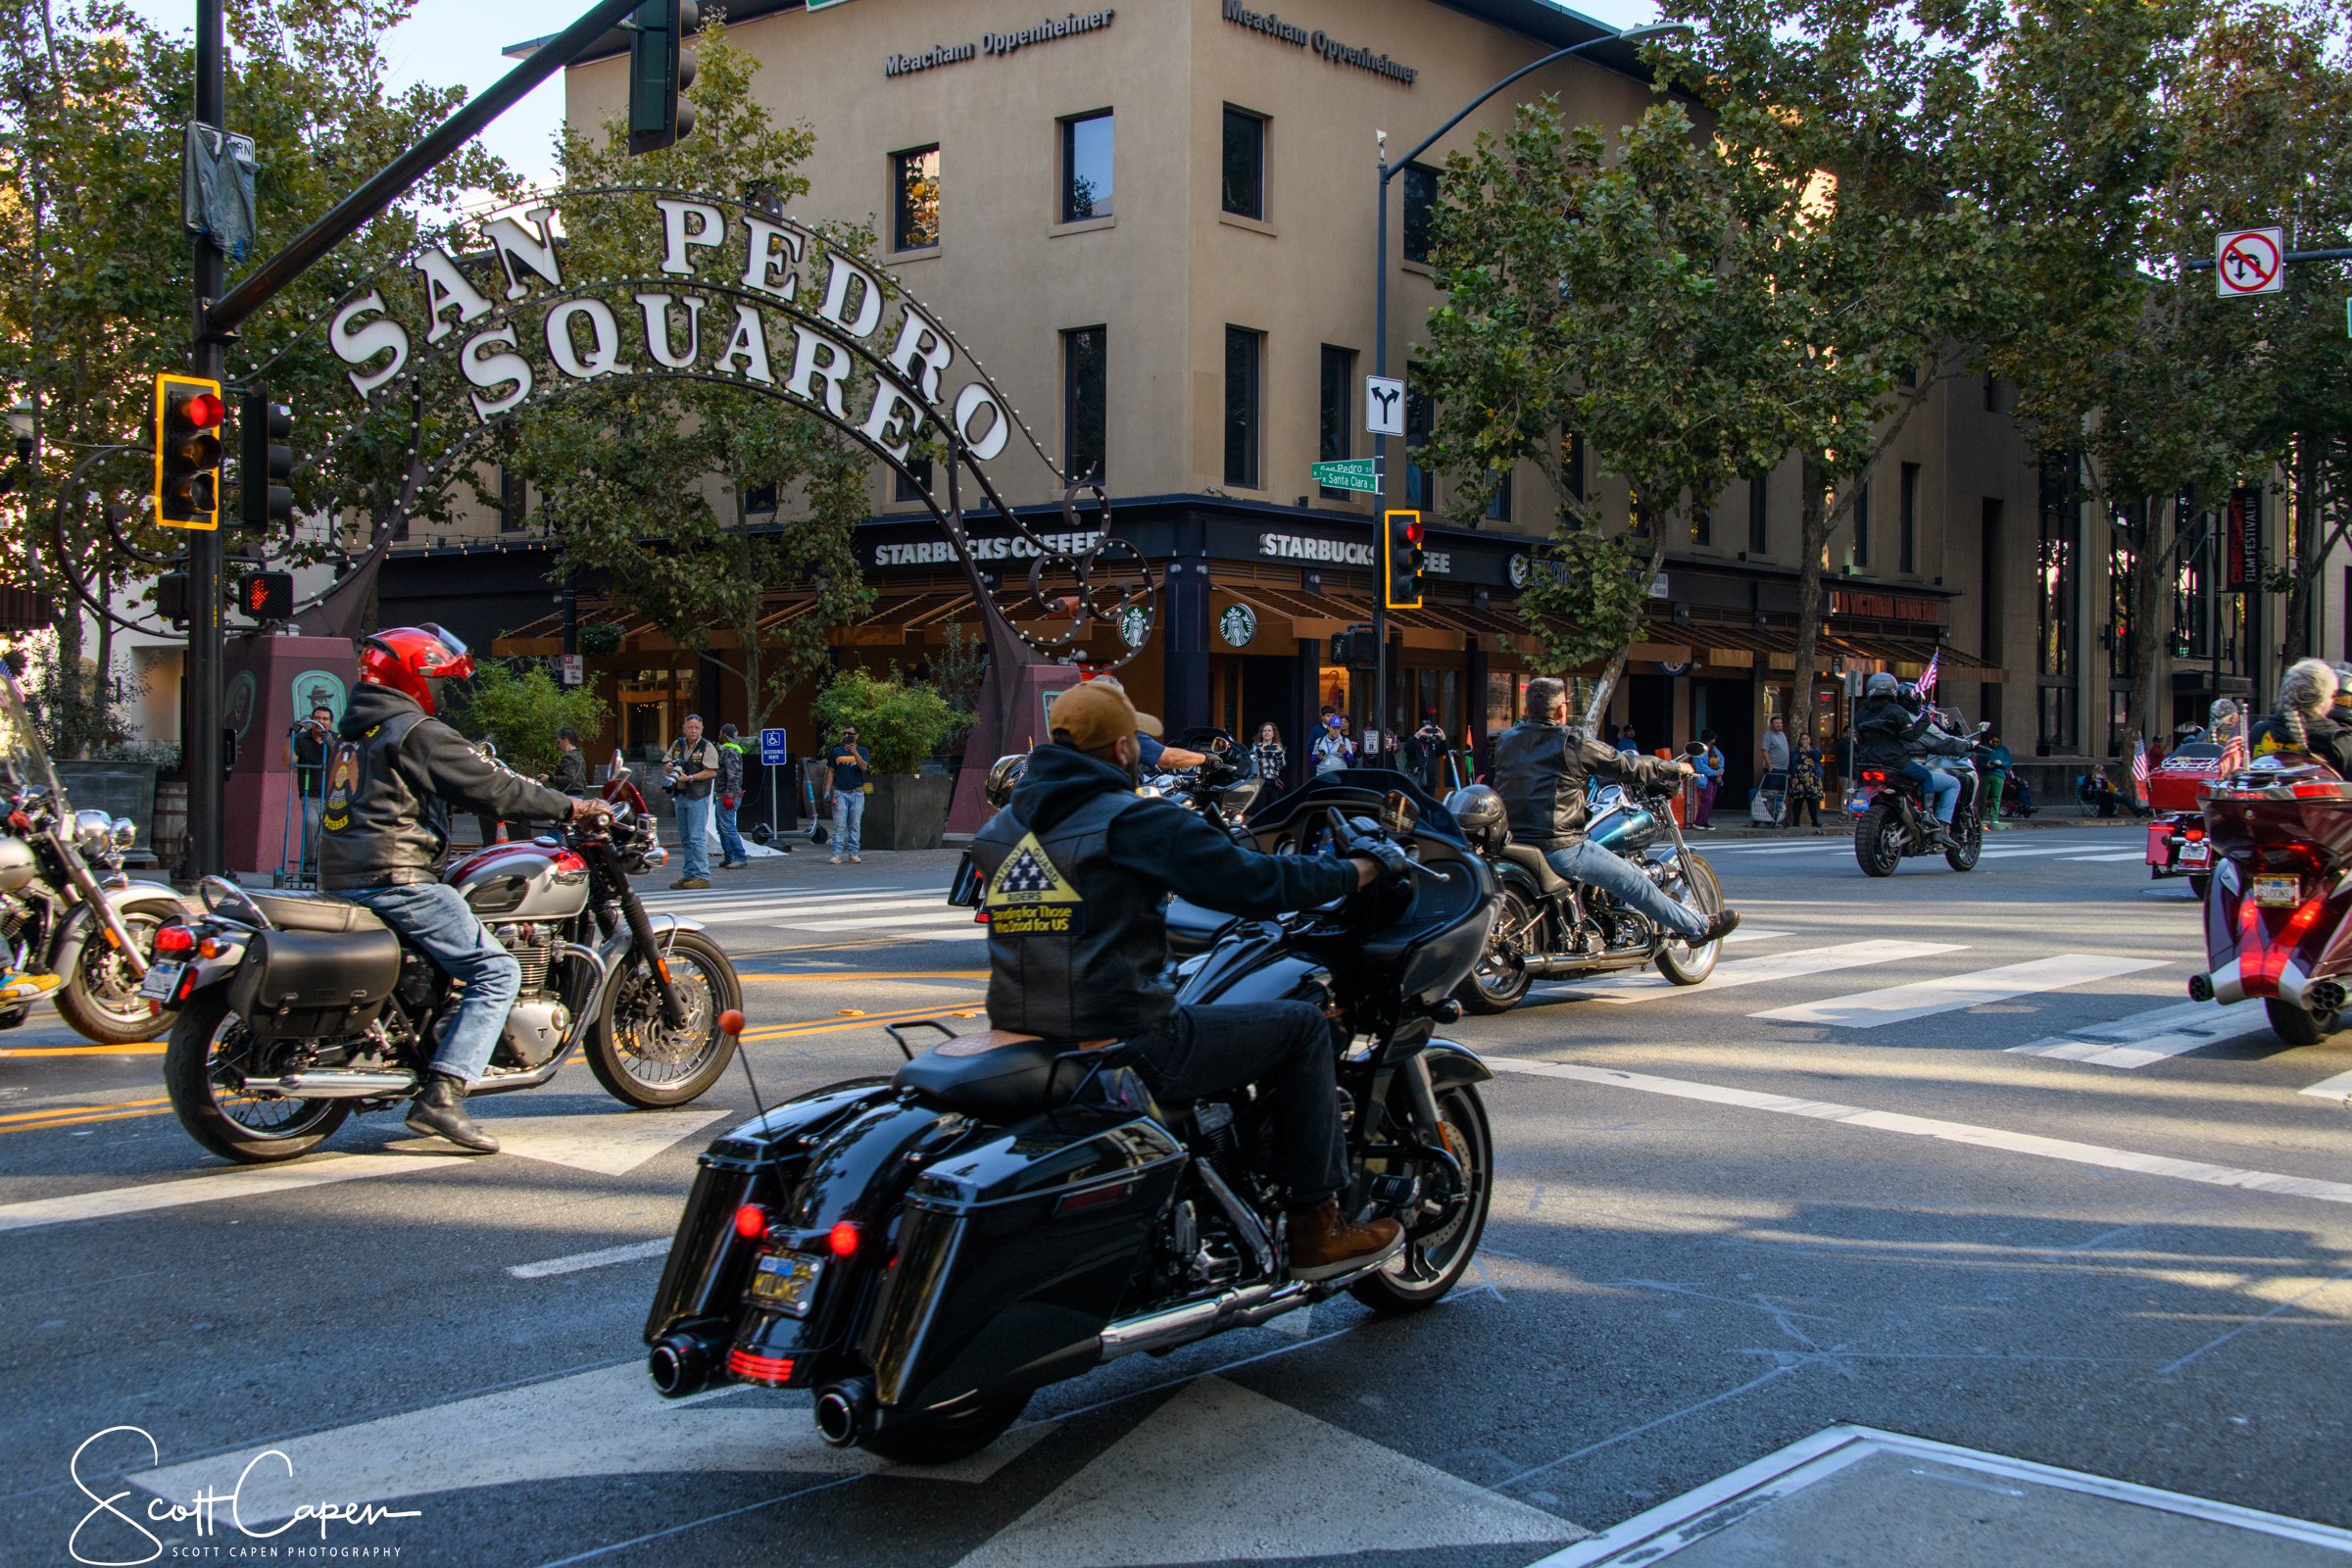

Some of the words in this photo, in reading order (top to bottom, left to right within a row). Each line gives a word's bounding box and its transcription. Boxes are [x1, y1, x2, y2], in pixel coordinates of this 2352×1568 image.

[884, 43, 975, 77] Meacham
[980, 8, 1115, 57] Oppenheimer
[1222, 0, 1308, 47] Meacham
[1311, 30, 1419, 84] Oppenheimer
[327, 206, 564, 400] SAN
[654, 198, 1011, 461] PEDRO
[459, 293, 929, 464] SQUARE
[1328, 472, 1348, 485] Santa
[1350, 476, 1368, 488] Clara
[1337, 464, 1362, 473] Pedro
[1260, 533, 1374, 565] STARBUCK
[2244, 509, 2256, 555] FESTIVAL
[2244, 559, 2256, 582] FILM
[1033, 847, 1059, 883] GUARD
[1022, 906, 1039, 918] for
[1039, 905, 1072, 918] Those
[1034, 918, 1051, 932] for
[1052, 917, 1069, 931] US
